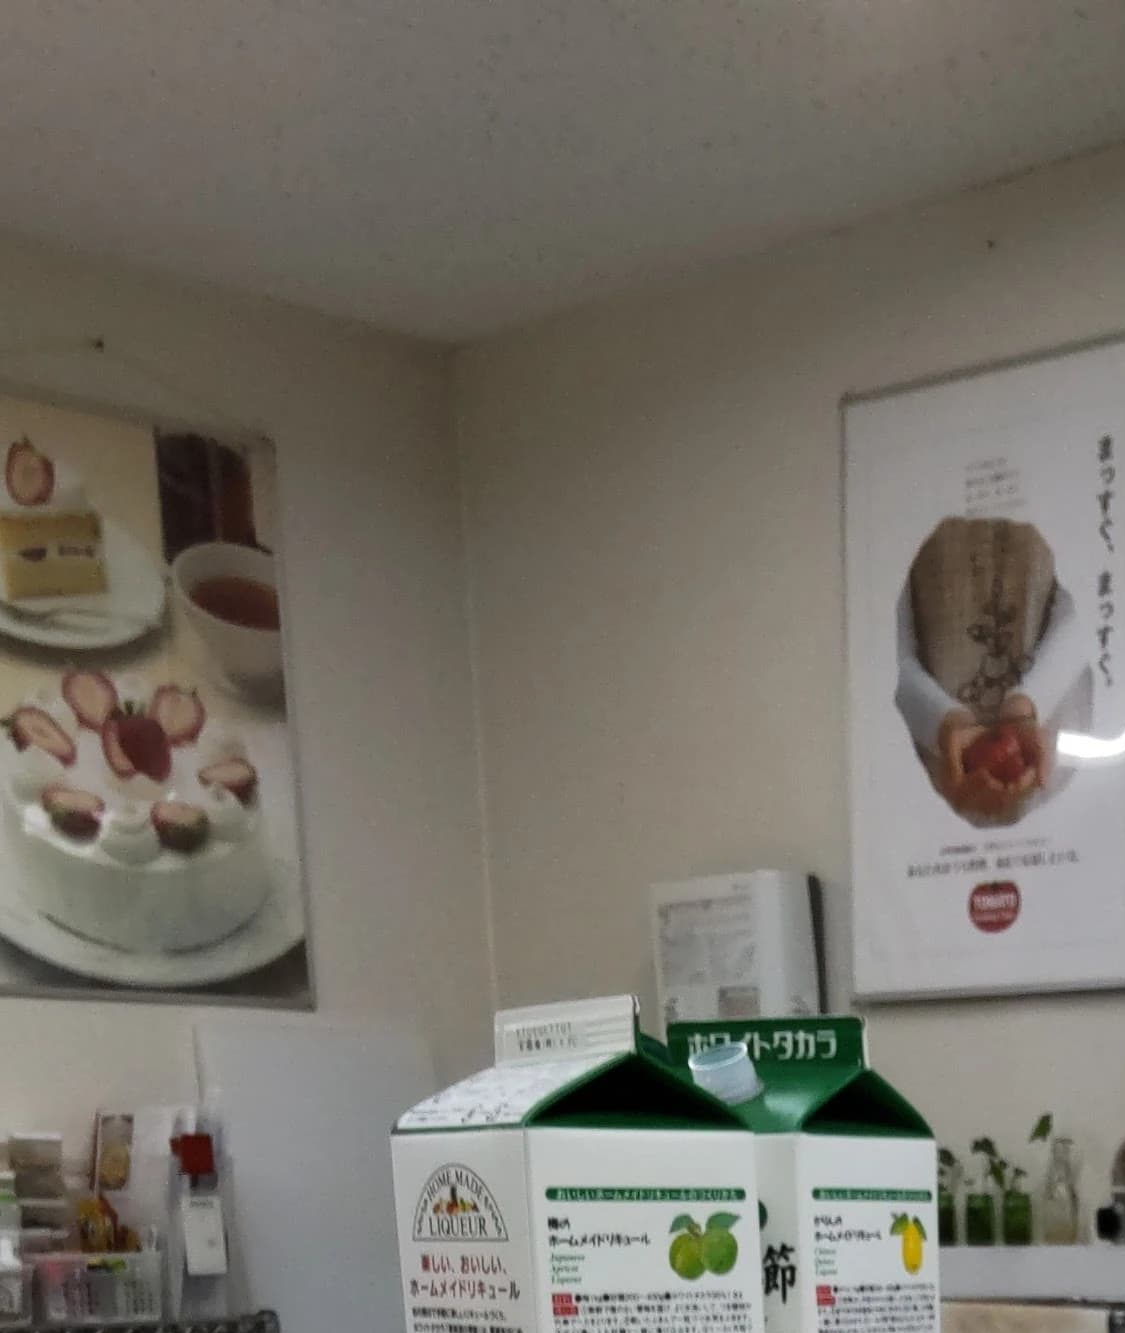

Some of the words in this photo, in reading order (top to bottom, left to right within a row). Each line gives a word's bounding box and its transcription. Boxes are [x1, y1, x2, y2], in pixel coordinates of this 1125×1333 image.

[426, 1171, 451, 1200] HOME
[455, 1170, 484, 1200] MADE
[429, 1217, 488, 1237] LIQUEUR
[549, 1233, 651, 1248] ホームメイドリキュール
[762, 1244, 795, 1304] 節
[410, 1280, 520, 1300] ホームメイドリキュール
